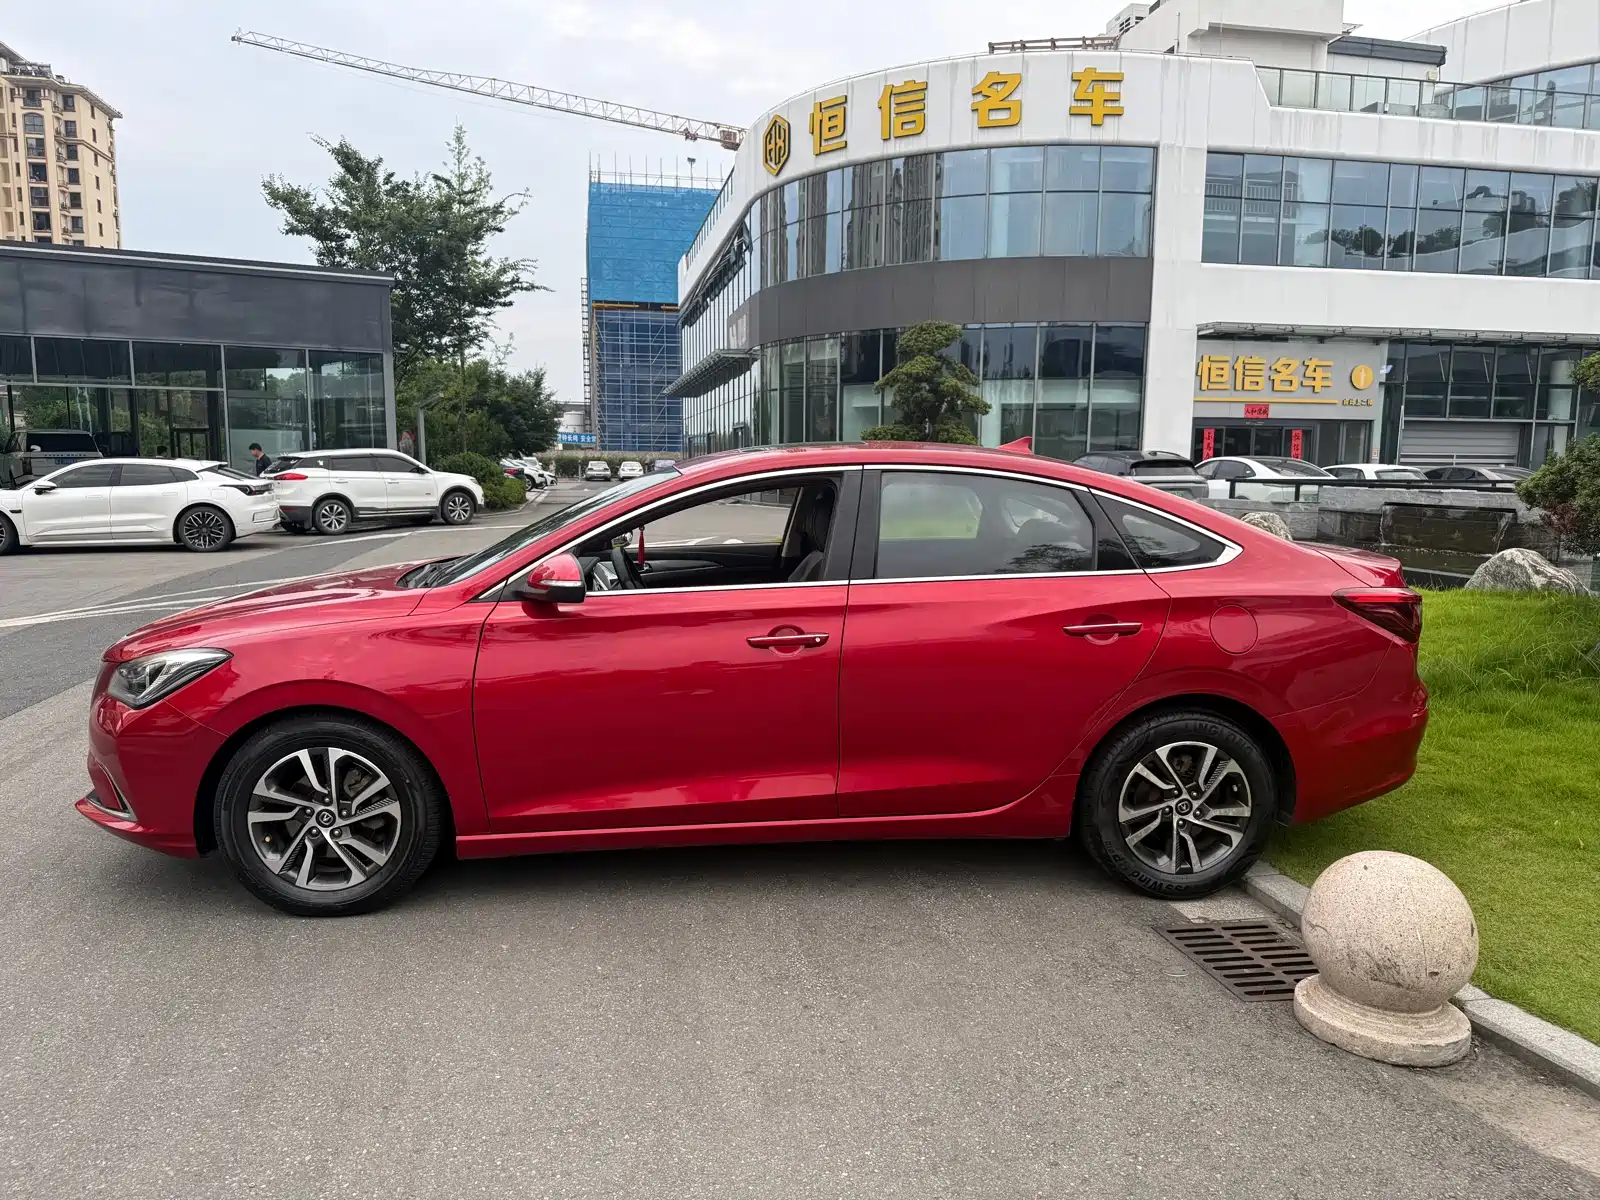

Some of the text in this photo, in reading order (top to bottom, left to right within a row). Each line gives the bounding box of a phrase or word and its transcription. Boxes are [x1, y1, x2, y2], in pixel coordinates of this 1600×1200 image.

[809, 67, 1125, 155] 恒信名车
[1197, 355, 1334, 393] 恒信名车
